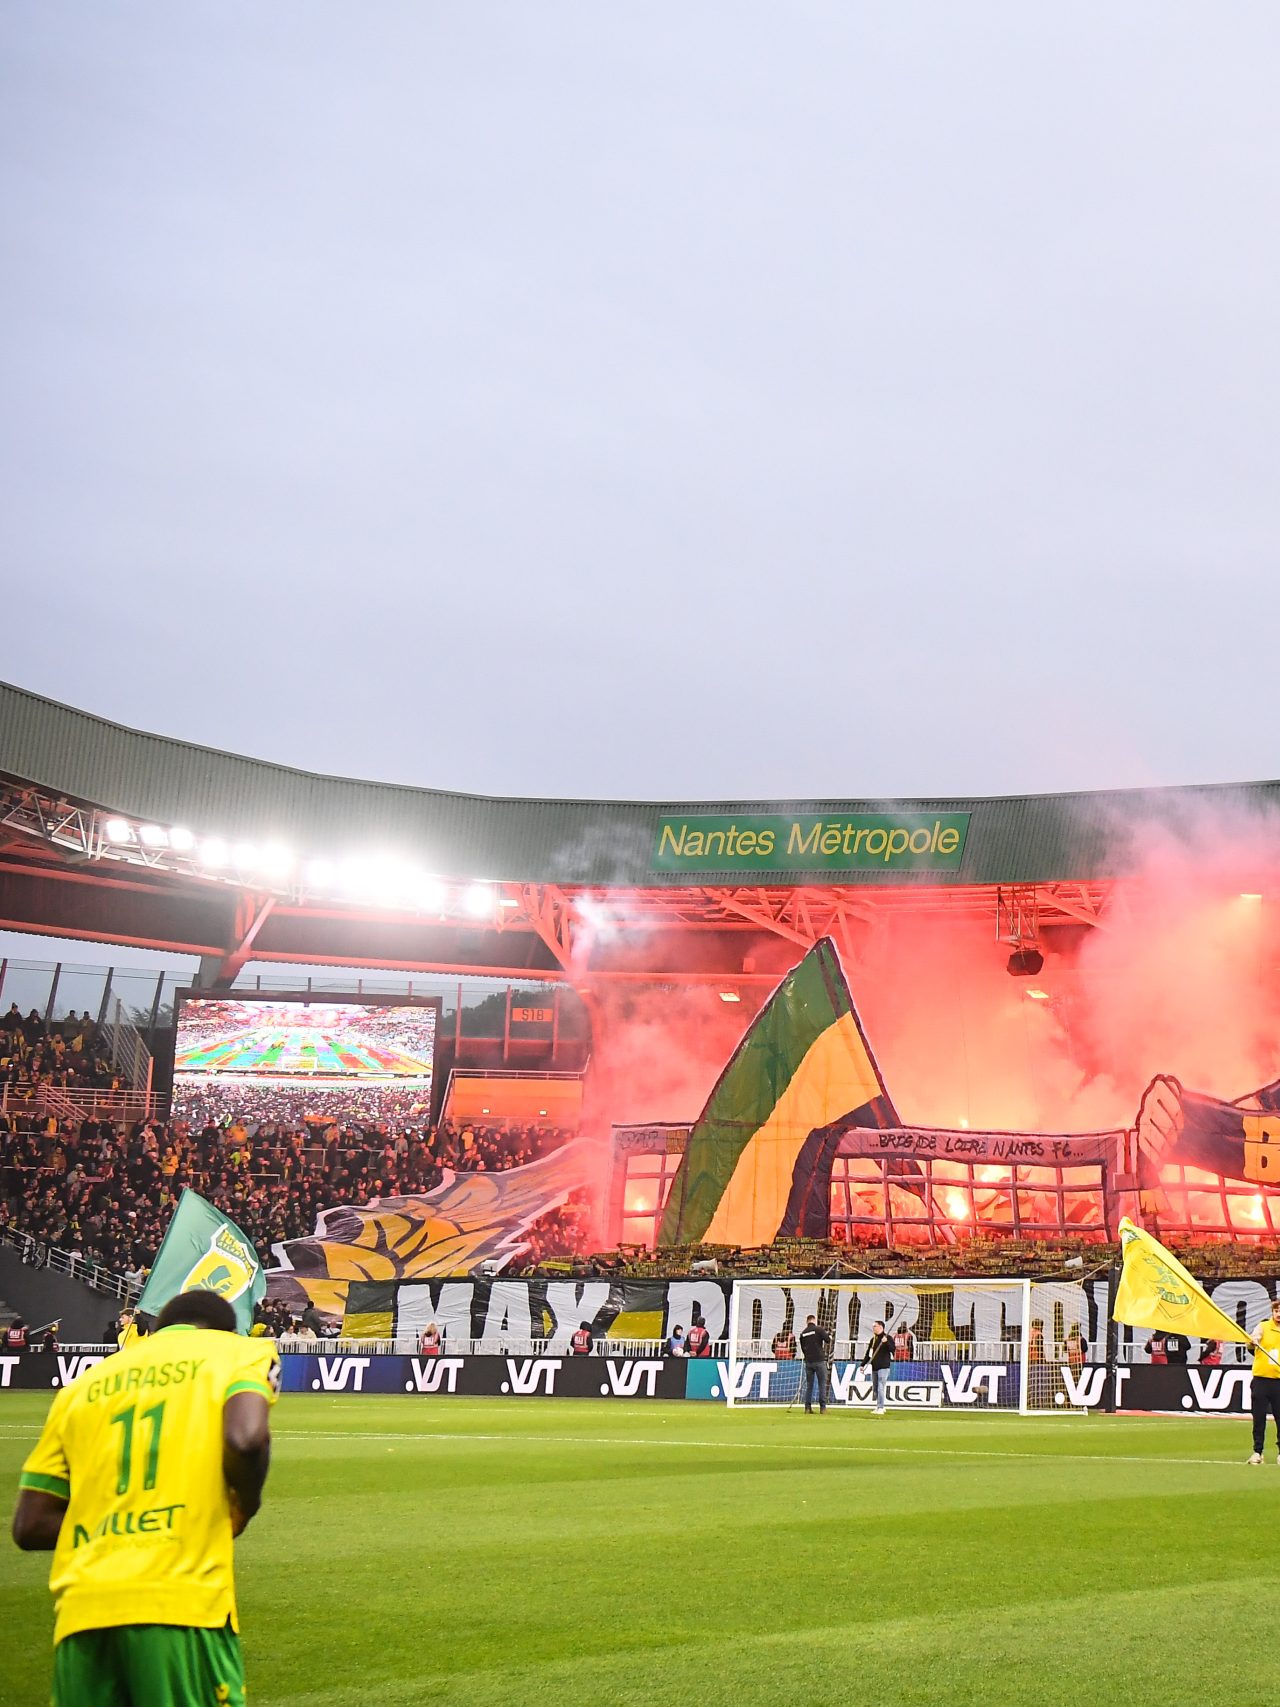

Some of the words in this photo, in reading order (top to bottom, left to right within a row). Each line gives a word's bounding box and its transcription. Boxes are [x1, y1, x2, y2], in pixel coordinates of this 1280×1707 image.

[658, 824, 776, 856] Nantes
[397, 1281, 611, 1356] MAY
[87, 1359, 206, 1403] GUIRASSY
[848, 1385, 940, 1402] MLLET
[111, 1400, 166, 1496] 11
